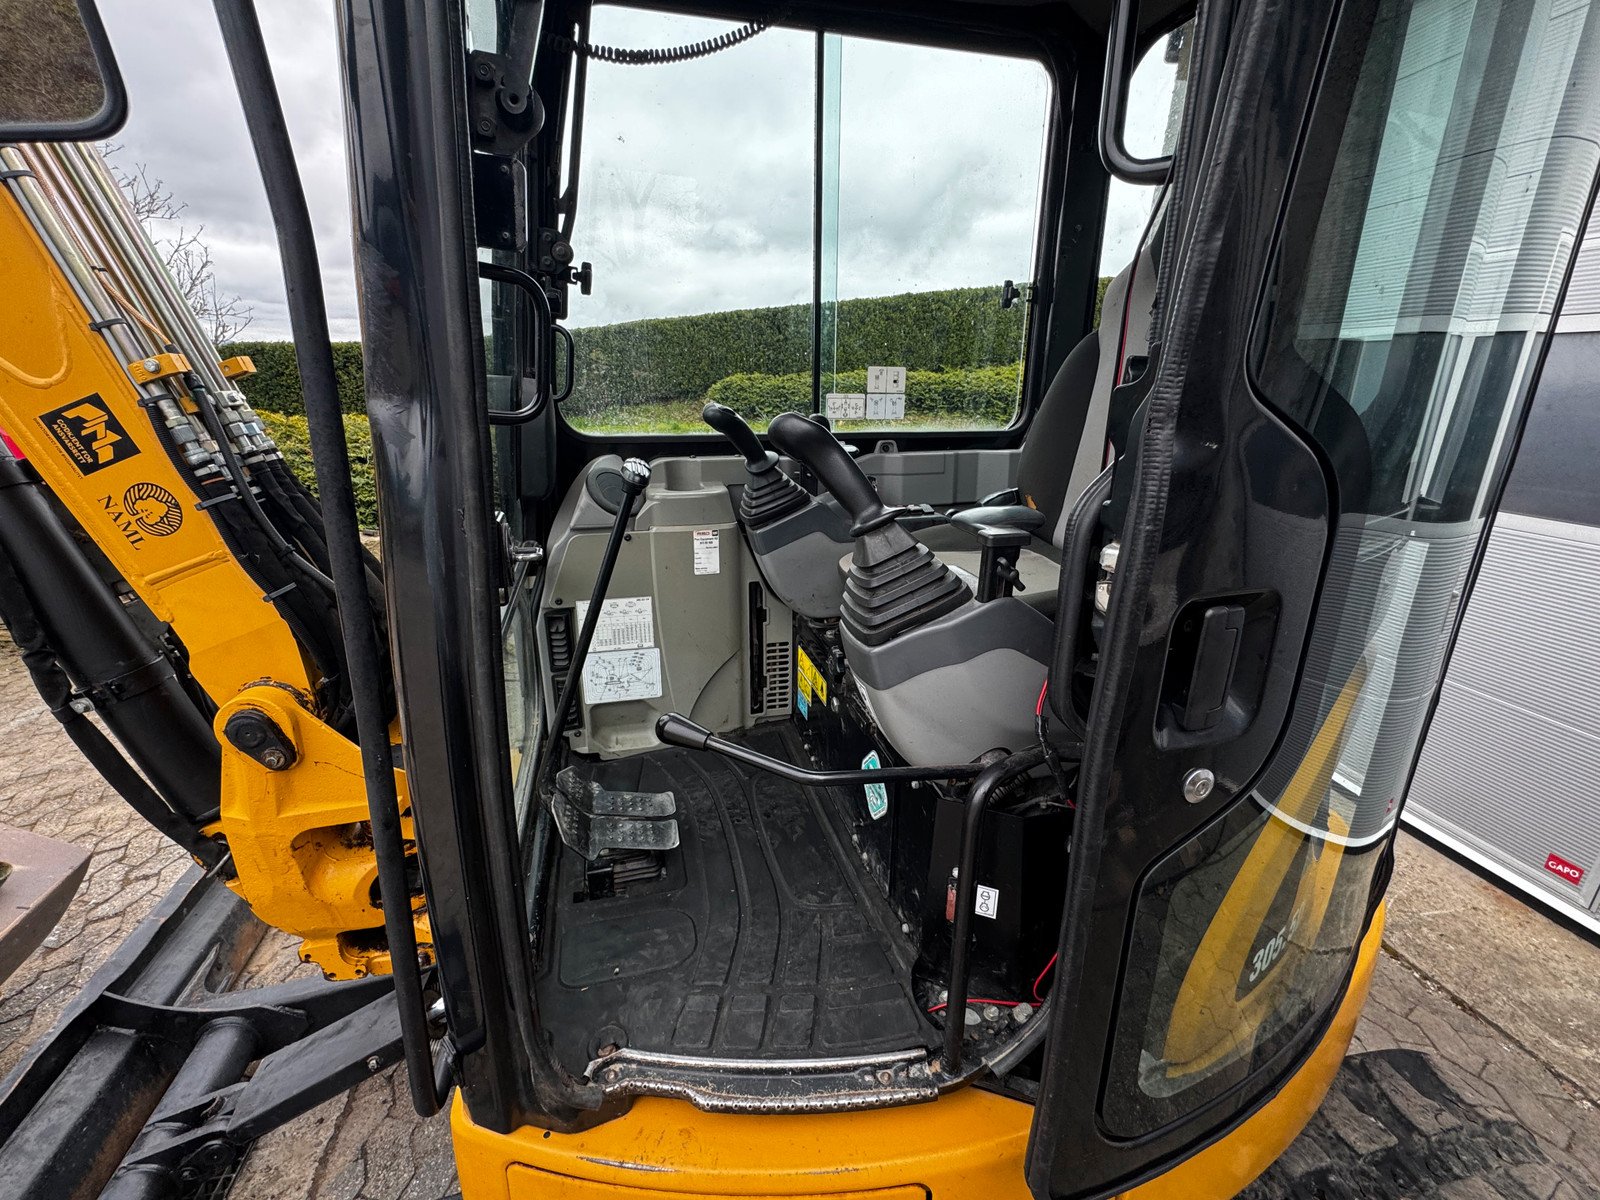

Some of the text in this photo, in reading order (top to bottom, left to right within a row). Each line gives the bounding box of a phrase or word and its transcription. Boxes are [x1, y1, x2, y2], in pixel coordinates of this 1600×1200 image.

[52, 424, 86, 463] ANSVARSRETT
[57, 419, 94, 463] GODKJENT FOR
[97, 494, 146, 550] NAML
[1548, 861, 1579, 878] GAPO
